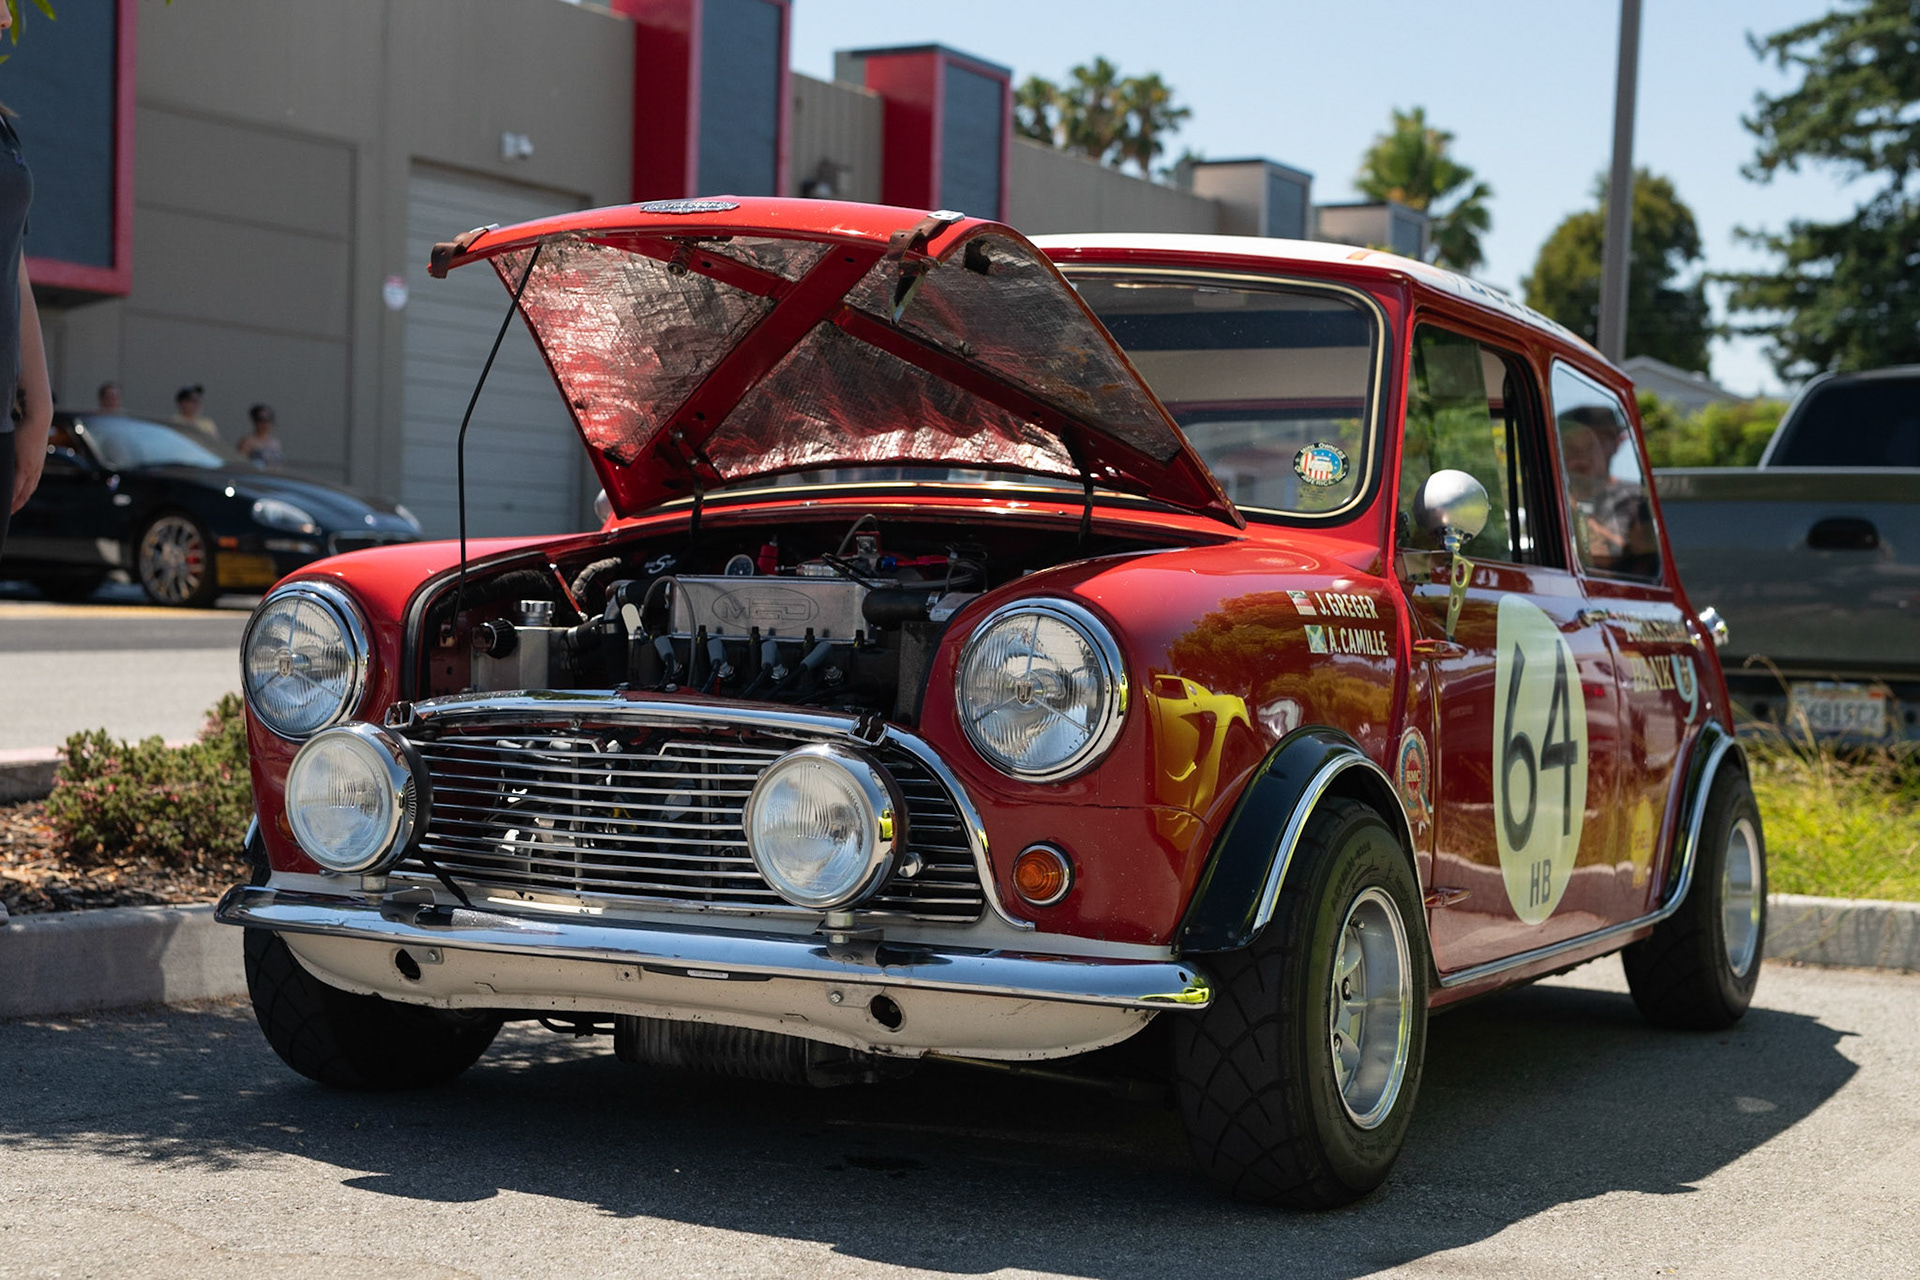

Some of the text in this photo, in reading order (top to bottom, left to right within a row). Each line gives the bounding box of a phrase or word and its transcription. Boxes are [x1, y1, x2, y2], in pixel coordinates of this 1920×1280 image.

[1300, 442, 1347, 460] MINI OWNERS
[721, 597, 812, 621] MED
[1630, 655, 1676, 693] BANK
[1501, 639, 1578, 852] 64
[1406, 769, 1421, 783] BMC
[1529, 859, 1552, 908] HB
